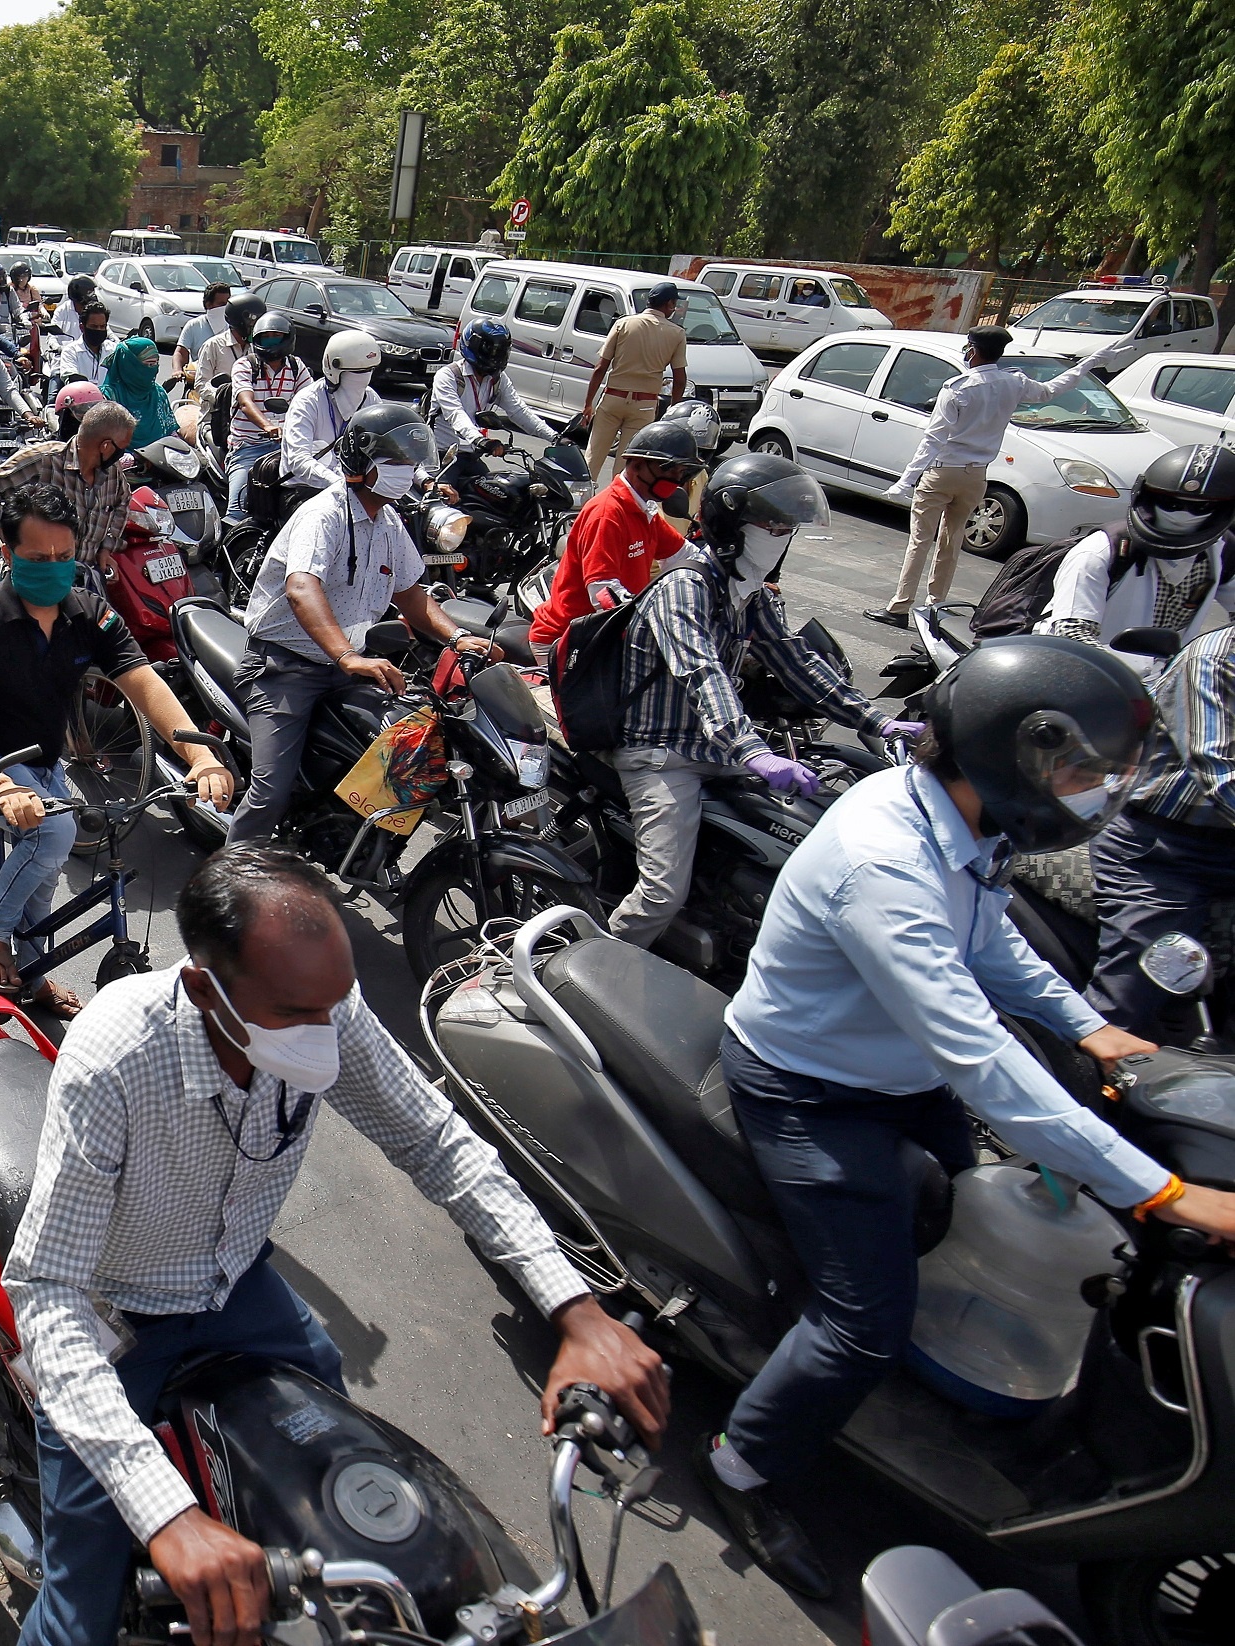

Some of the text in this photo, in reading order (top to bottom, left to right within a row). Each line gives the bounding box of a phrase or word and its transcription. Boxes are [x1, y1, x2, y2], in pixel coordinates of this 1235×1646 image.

[143, 548, 163, 556] HONDA
[769, 822, 803, 845] Hero
[53, 938, 85, 961] STITCH
